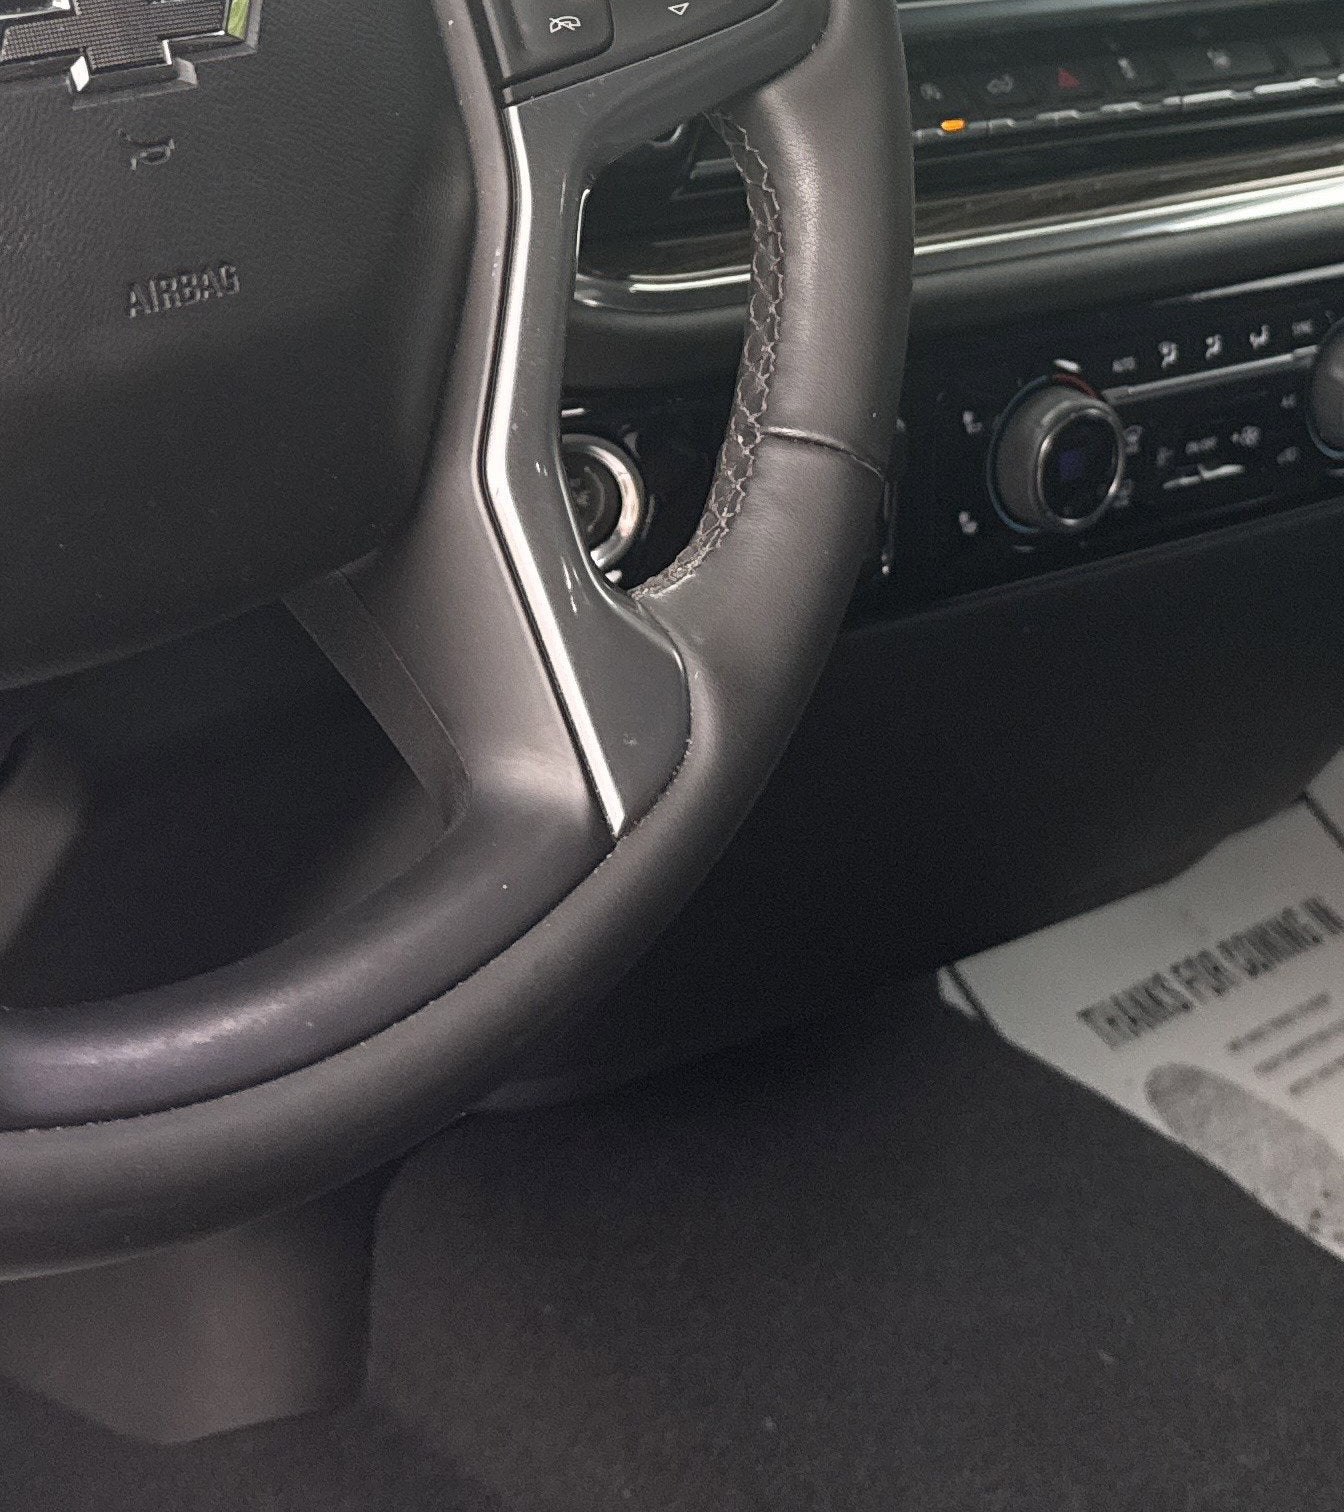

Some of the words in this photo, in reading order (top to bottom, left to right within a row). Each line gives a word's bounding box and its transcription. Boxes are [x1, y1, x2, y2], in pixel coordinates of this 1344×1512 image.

[125, 262, 242, 318] AIRBAG
[1077, 972, 1195, 1050] THANKS
[1169, 949, 1238, 1001] FOR
